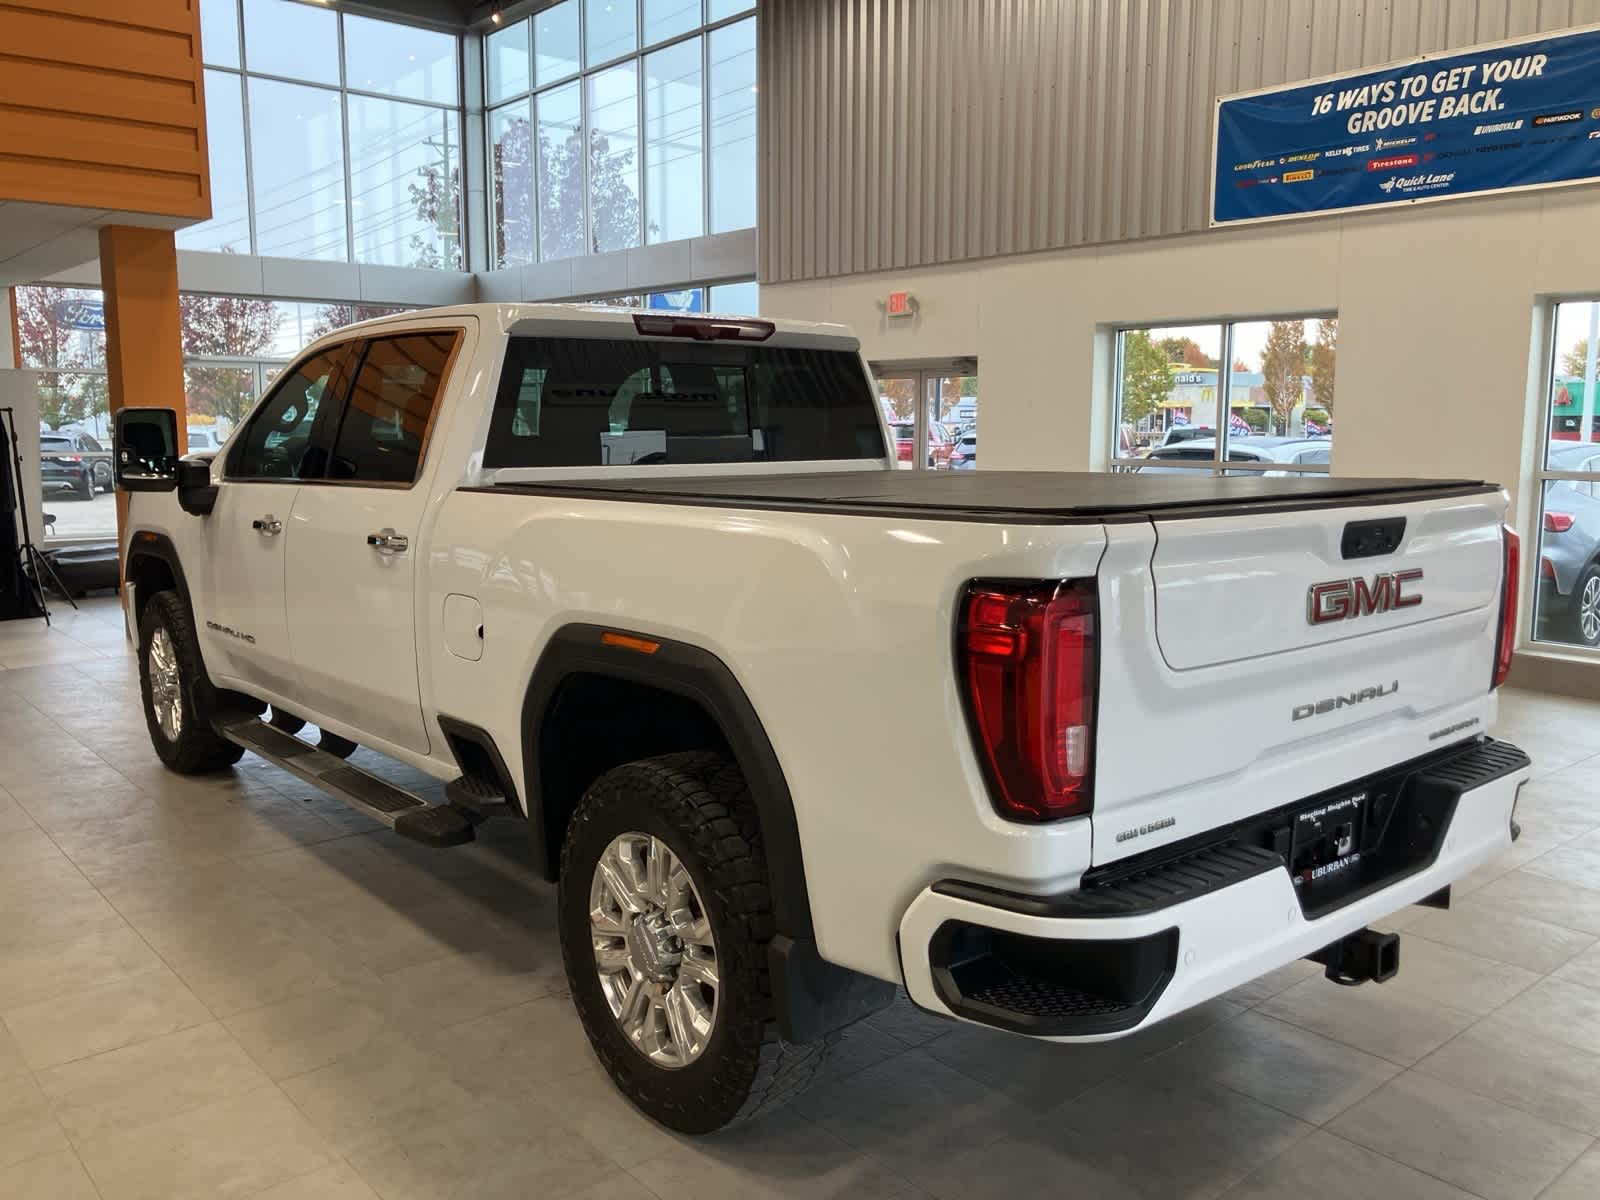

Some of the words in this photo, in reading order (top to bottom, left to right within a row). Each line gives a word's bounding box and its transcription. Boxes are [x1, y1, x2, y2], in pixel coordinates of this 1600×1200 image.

[1311, 93, 1333, 116] 16
[1336, 80, 1397, 112] WAYS
[1400, 74, 1428, 100] TO
[1431, 66, 1476, 94] GET
[1481, 54, 1548, 85] YOUR
[1347, 99, 1437, 135] GROOVE
[1438, 87, 1505, 119] BACK.
[1481, 120, 1515, 135] UNIROYAL
[1287, 151, 1321, 163] DUNLOP
[1324, 149, 1342, 158] KELLY
[1353, 144, 1370, 154] TIRES
[1234, 159, 1276, 172] GOODYEAR
[1372, 157, 1414, 169] Firestone
[1395, 174, 1427, 189] Quick
[1426, 172, 1455, 184] Lane
[64, 303, 104, 324] For
[1306, 567, 1424, 626] GMC
[1291, 679, 1399, 721] DENALI
[1309, 857, 1349, 880] UBURBAN
